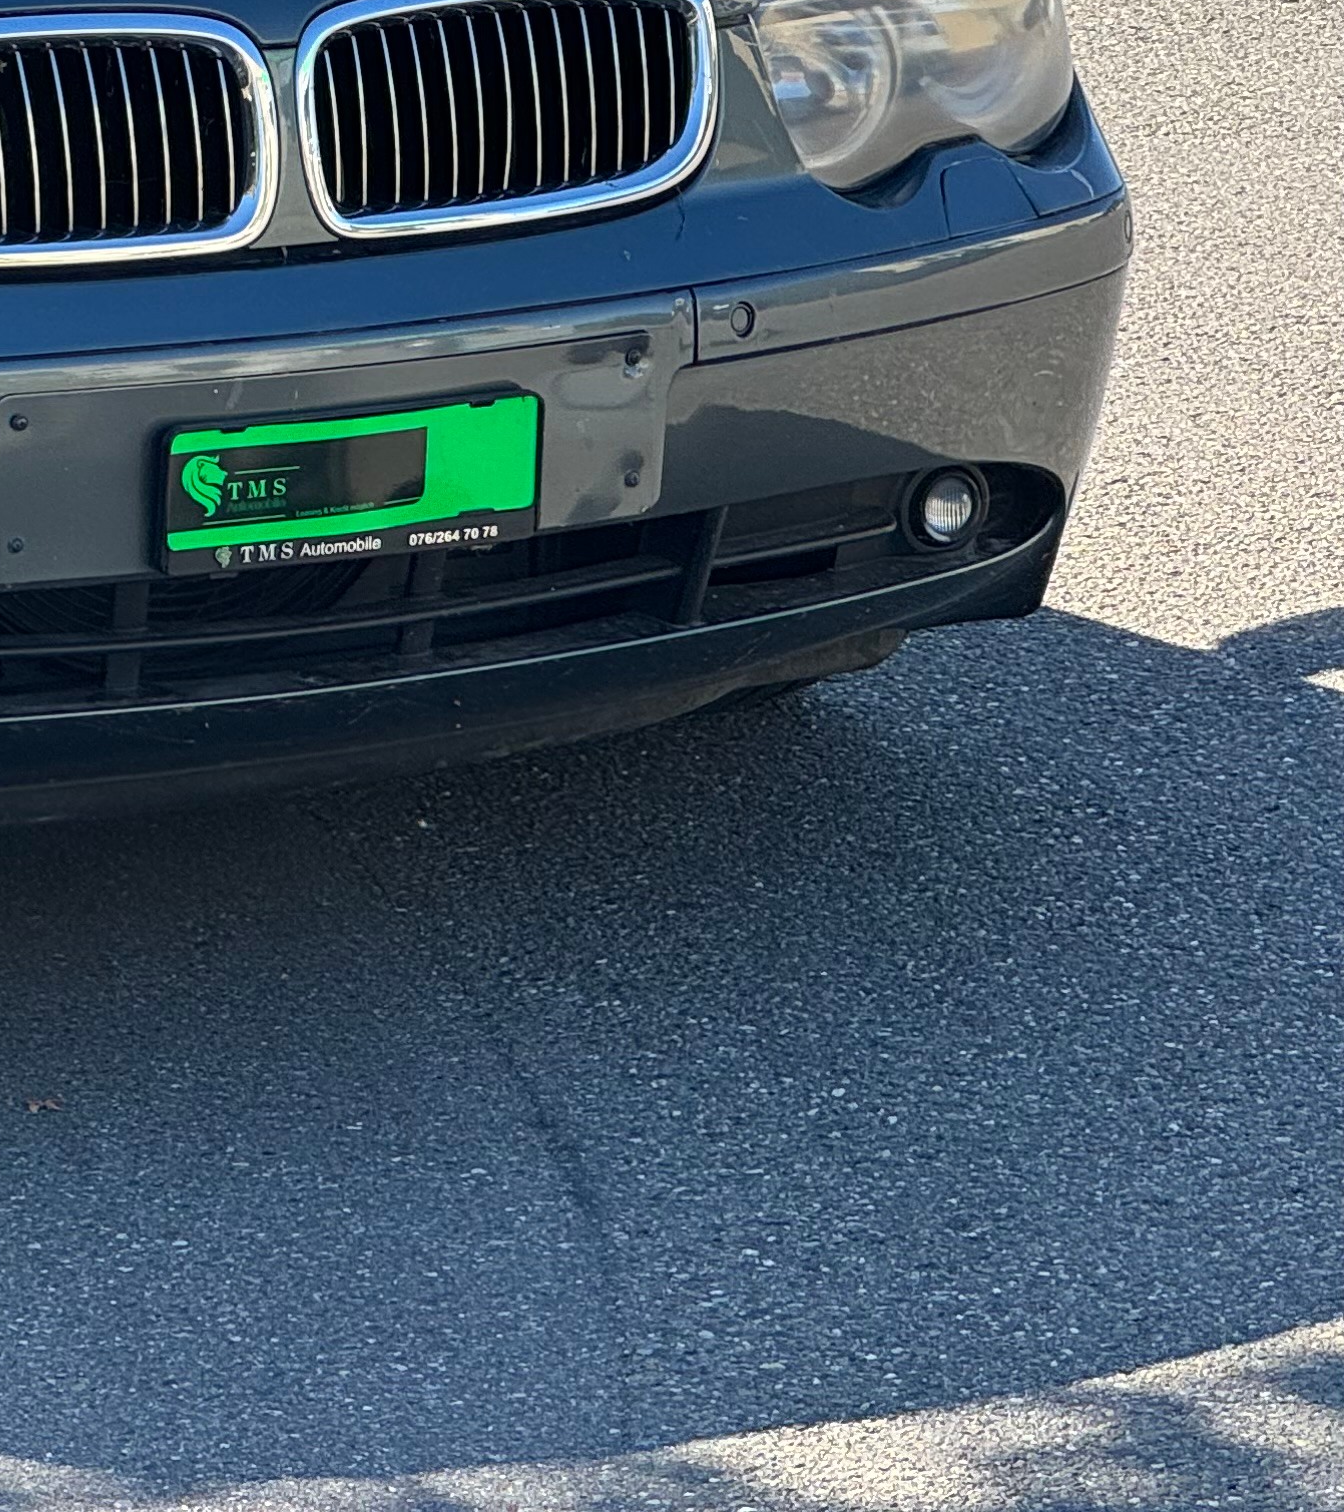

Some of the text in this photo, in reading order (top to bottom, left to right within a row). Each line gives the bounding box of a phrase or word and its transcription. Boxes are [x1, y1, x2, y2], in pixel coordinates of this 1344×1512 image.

[299, 535, 382, 558] Automobile
[409, 529, 460, 546] 076/264
[463, 527, 479, 541] 70
[482, 525, 499, 539] 78
